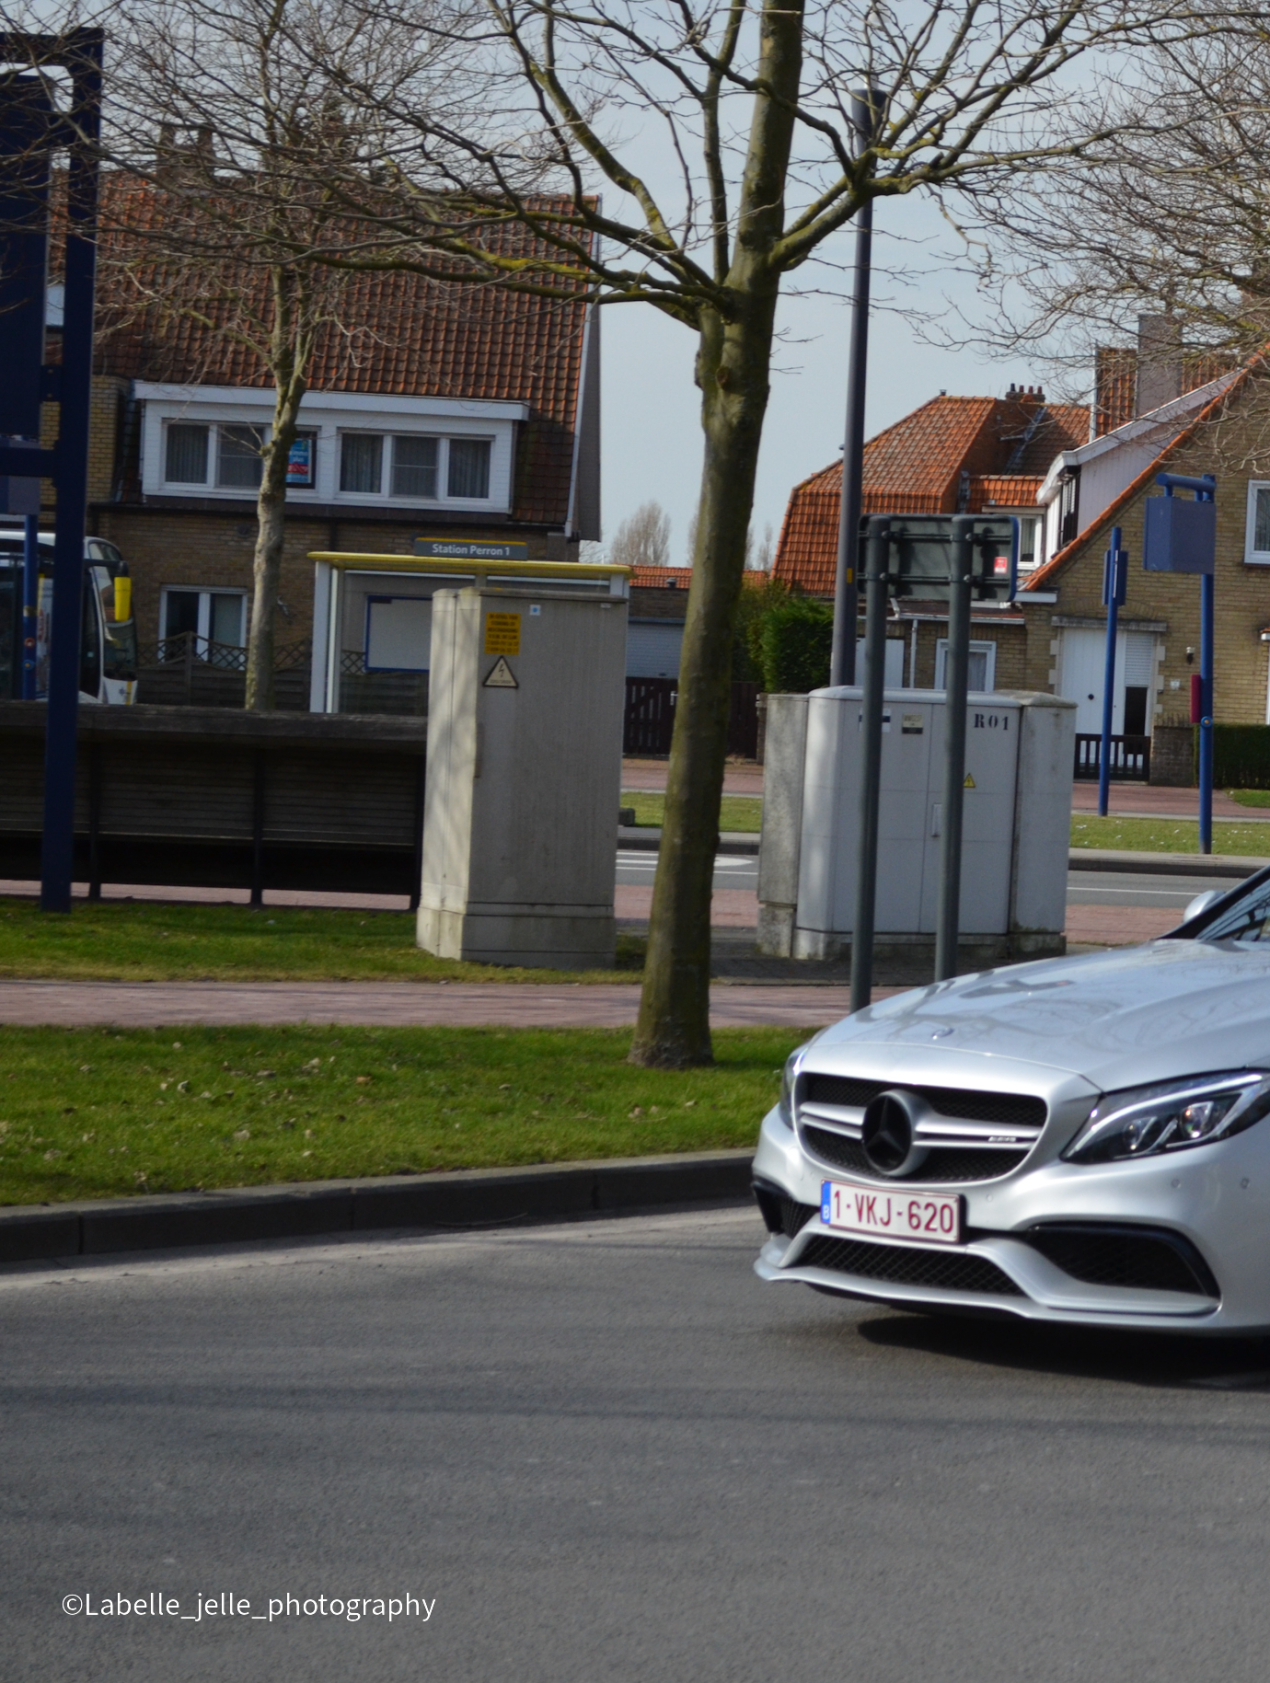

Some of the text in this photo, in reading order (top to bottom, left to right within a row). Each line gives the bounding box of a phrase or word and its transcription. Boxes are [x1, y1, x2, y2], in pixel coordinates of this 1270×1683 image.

[432, 543, 510, 556] Station Perron 1
[974, 713, 1009, 731] R01
[822, 1204, 830, 1220] B
